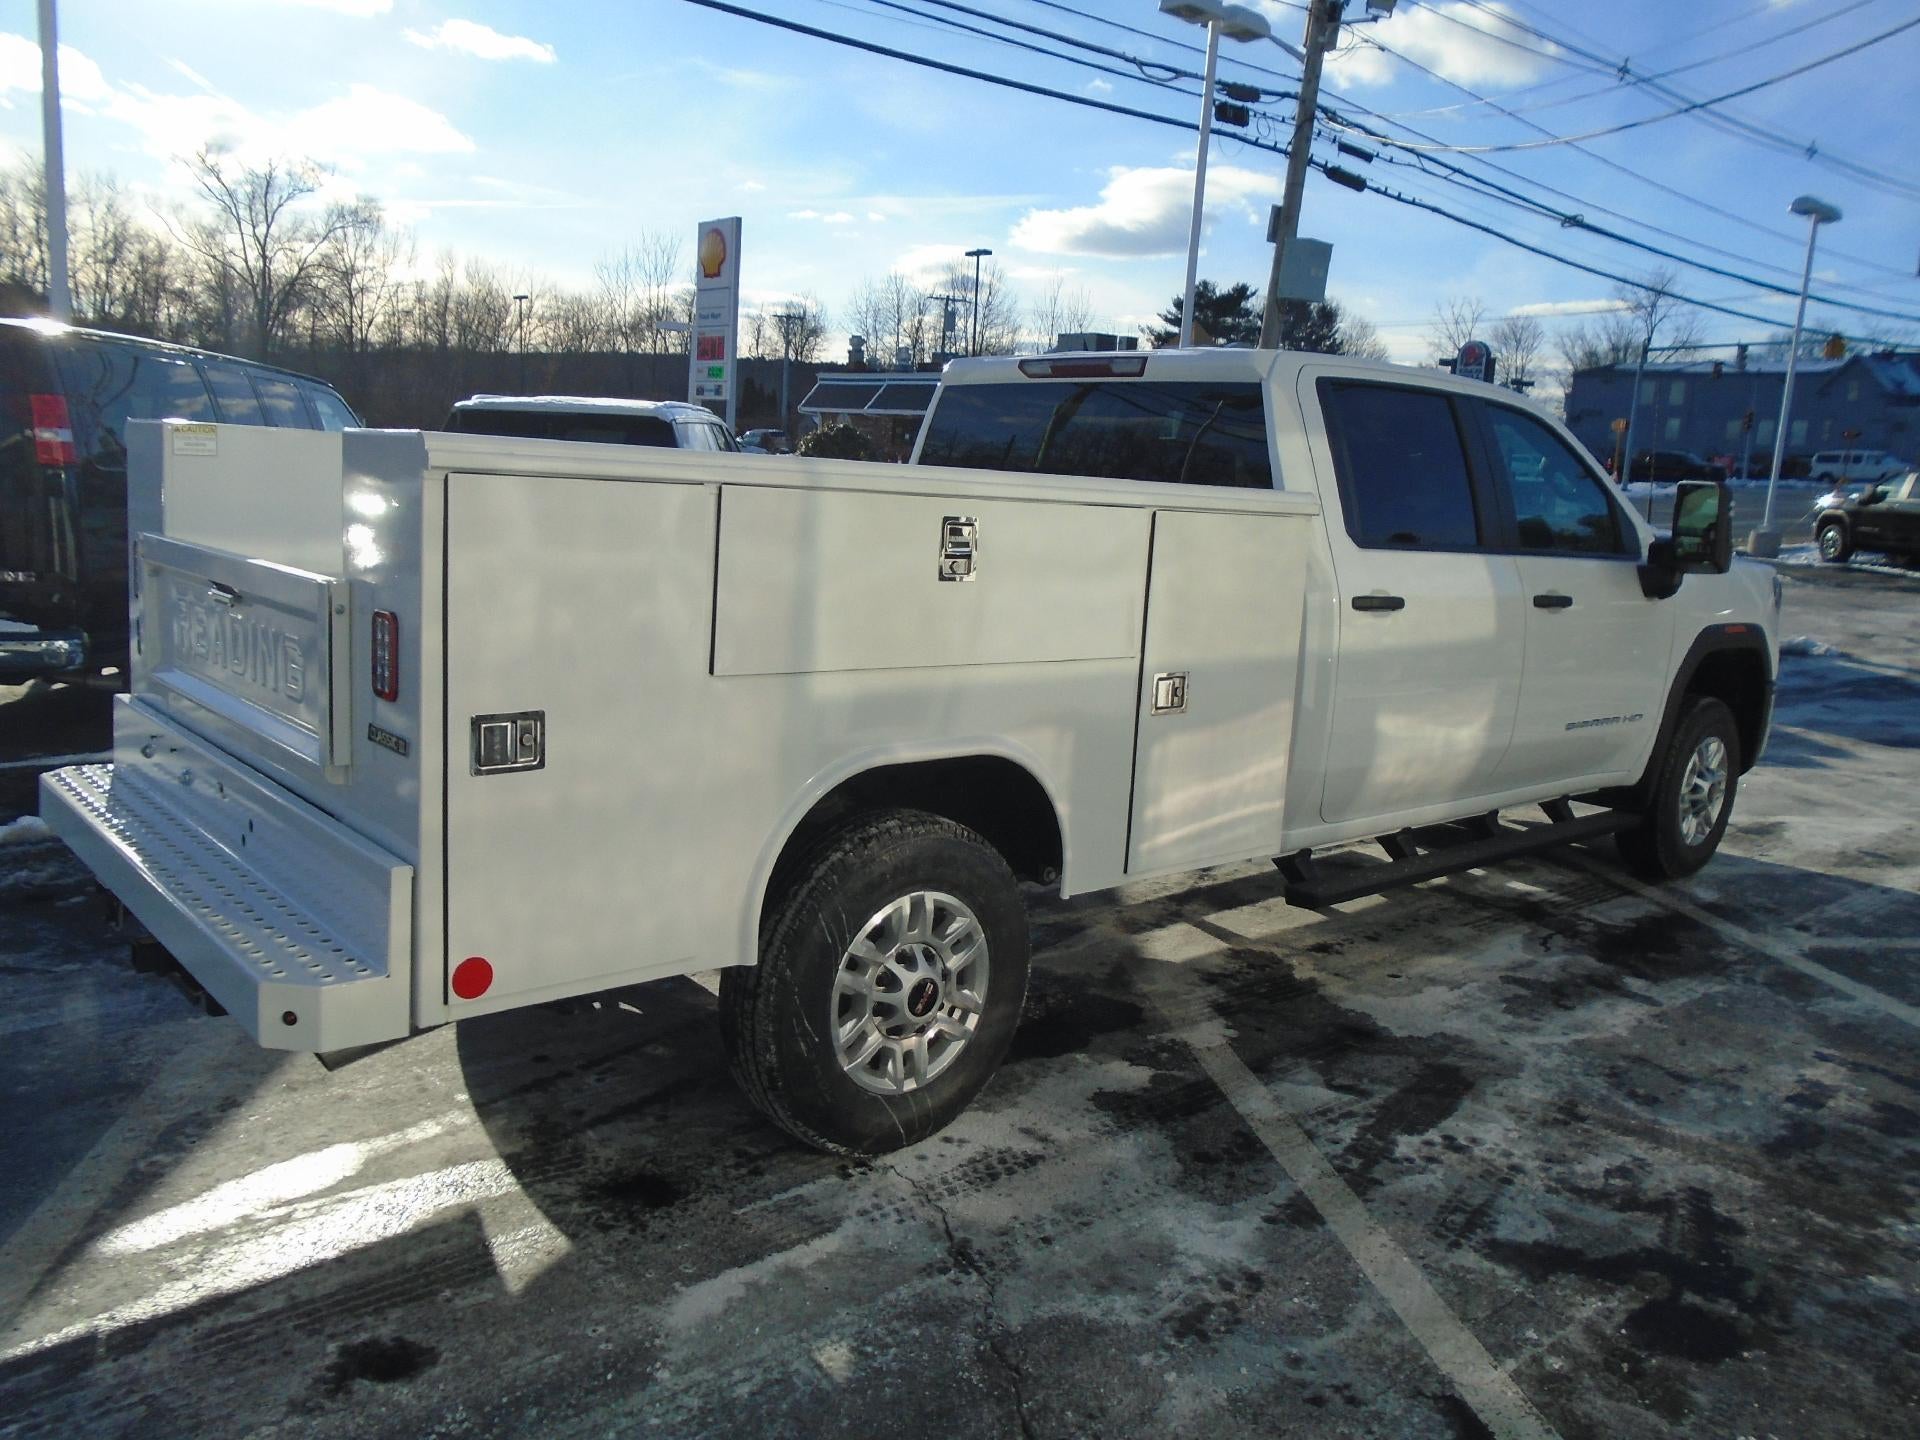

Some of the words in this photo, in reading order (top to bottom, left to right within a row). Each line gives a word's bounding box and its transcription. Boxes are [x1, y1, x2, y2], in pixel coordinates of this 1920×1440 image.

[181, 425, 216, 433] CAUTION
[173, 594, 305, 704] READING
[1565, 716, 1621, 731] SIERRA
[1622, 713, 1644, 723] HD
[370, 726, 398, 750] CLASSIC
